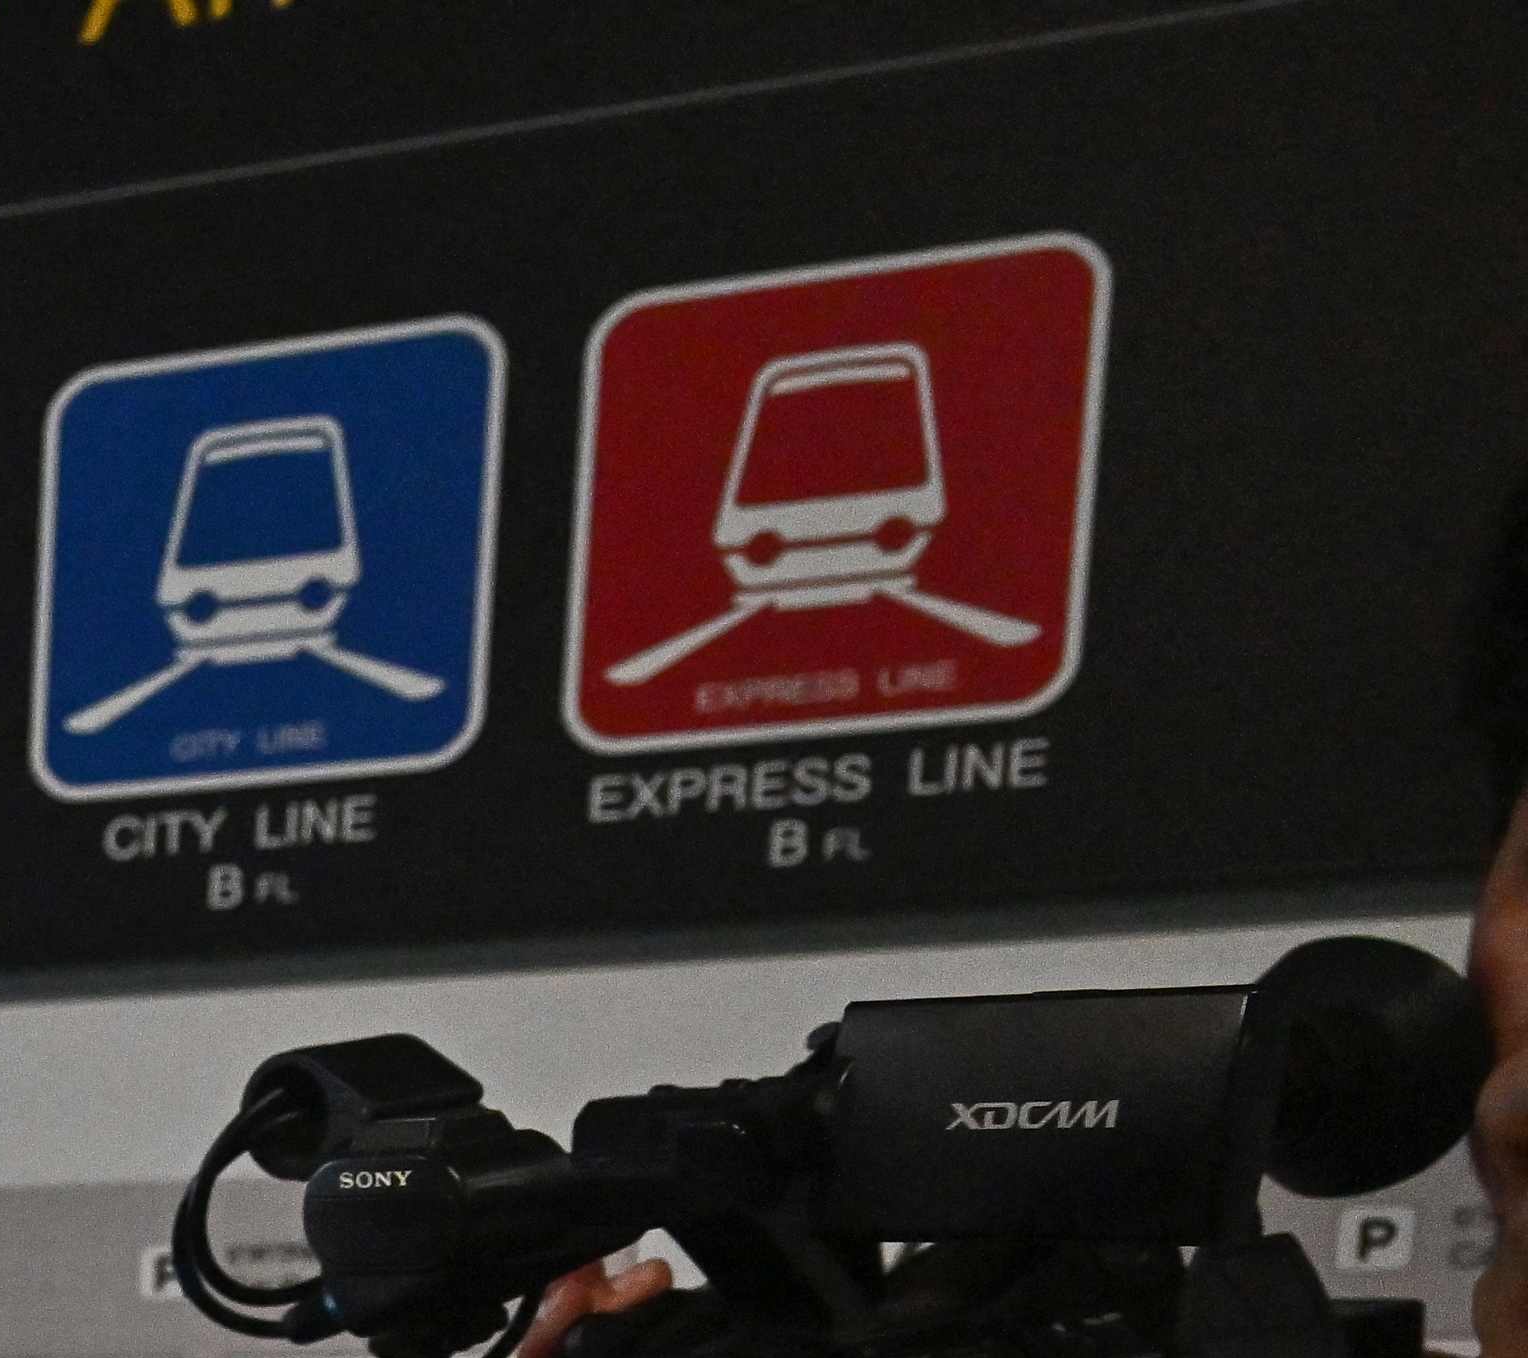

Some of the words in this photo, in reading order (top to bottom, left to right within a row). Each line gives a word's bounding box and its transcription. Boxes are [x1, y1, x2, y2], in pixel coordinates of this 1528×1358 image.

[588, 752, 873, 824] EXPRESS
[906, 737, 1051, 797] LINE
[102, 805, 228, 862] CITY
[253, 794, 377, 850] LINE
[766, 817, 810, 868] B
[206, 862, 245, 911] B
[944, 1098, 1121, 1132] XDCAM
[338, 1169, 413, 1190] SONY
[1357, 1215, 1399, 1264] P
